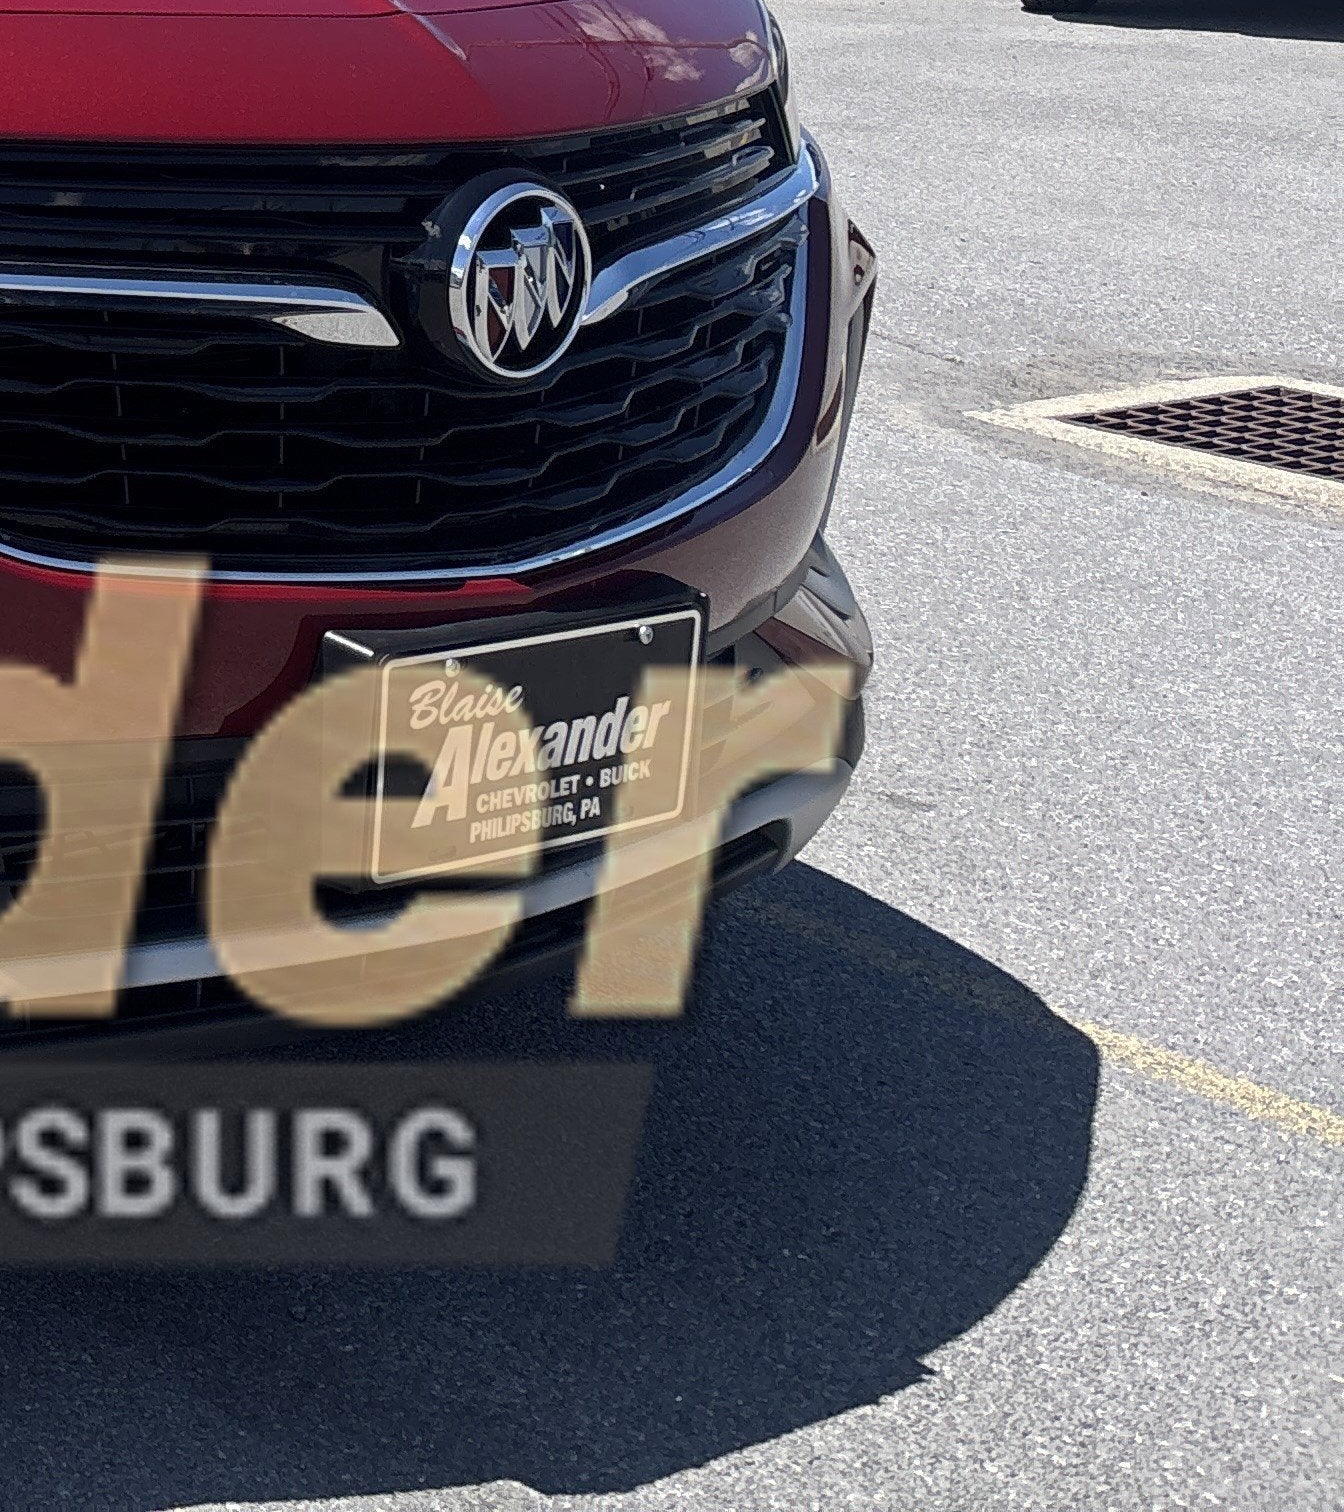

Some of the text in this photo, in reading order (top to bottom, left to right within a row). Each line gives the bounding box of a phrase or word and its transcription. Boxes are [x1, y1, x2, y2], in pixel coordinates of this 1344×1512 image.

[409, 679, 524, 730] Blaise
[410, 696, 672, 829] Alexander
[476, 759, 652, 814] CHEVROLET BUICK
[579, 797, 601, 819] PA
